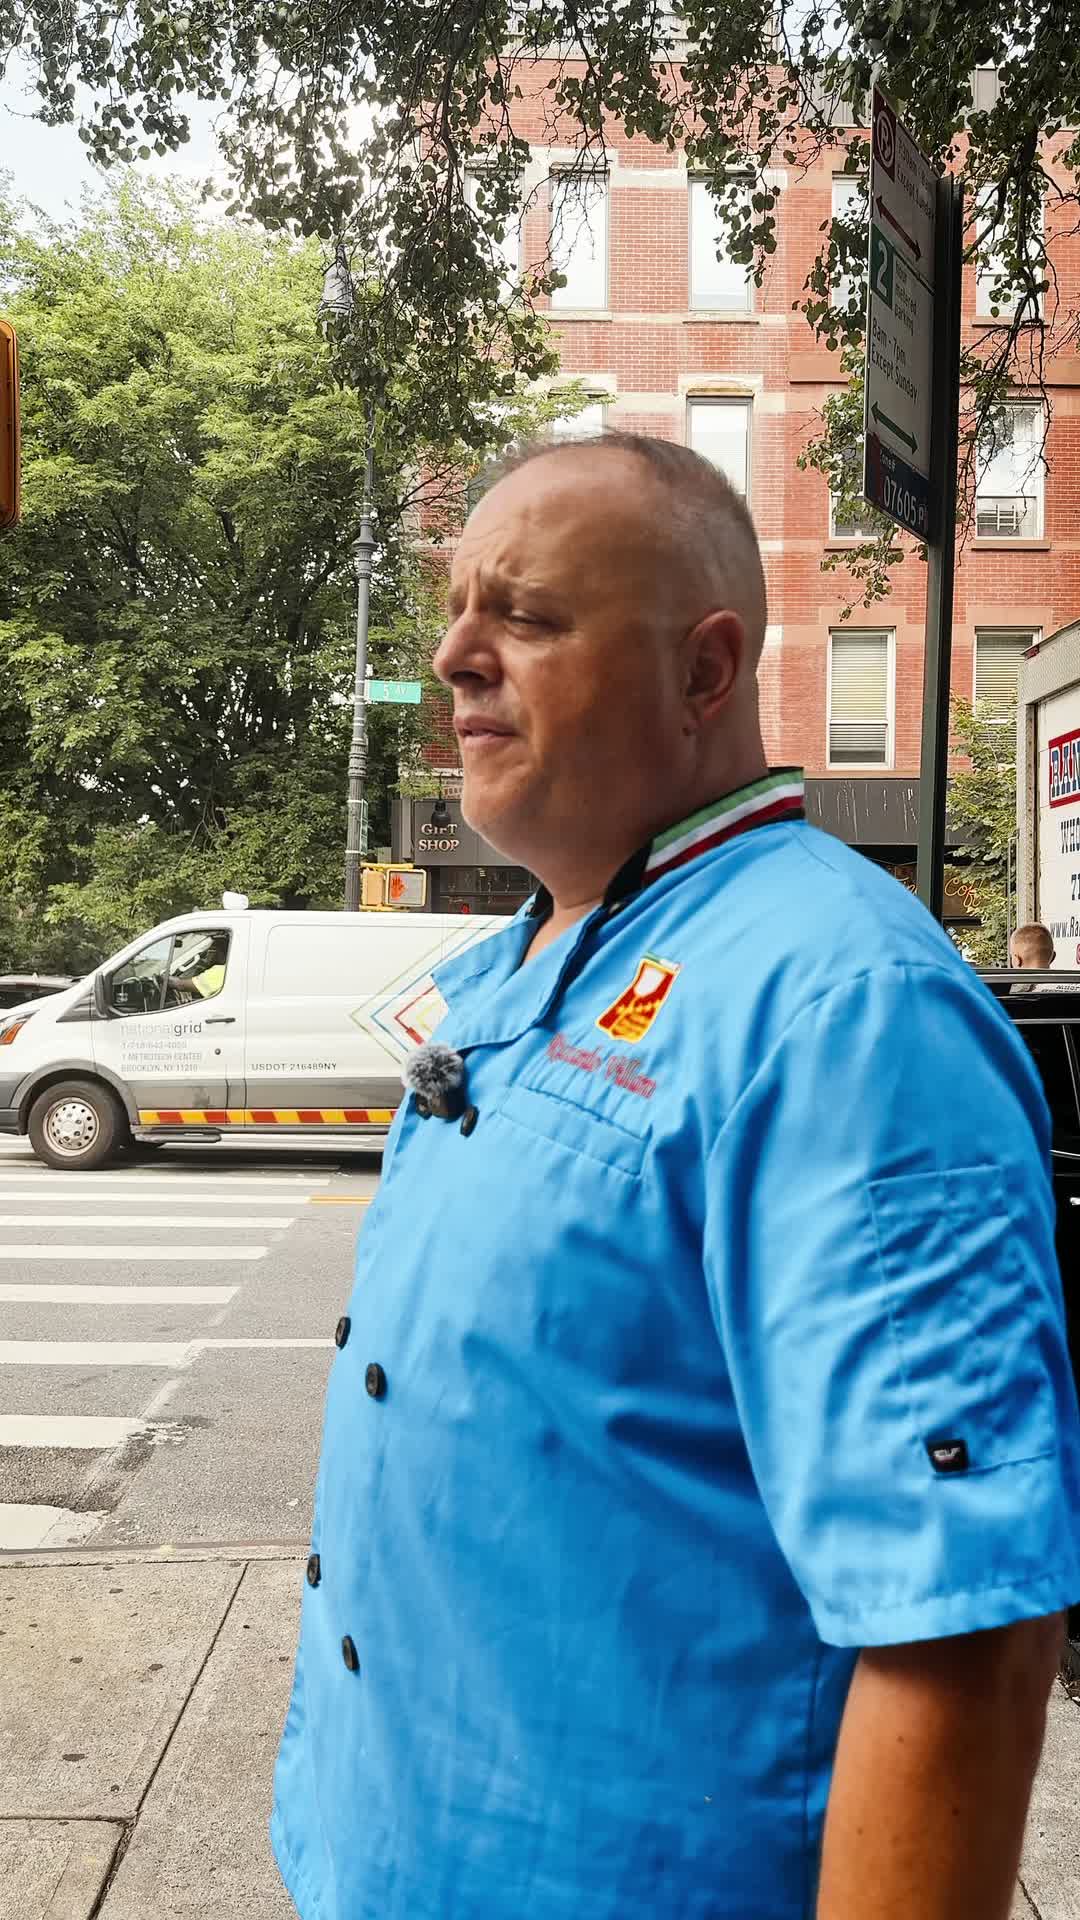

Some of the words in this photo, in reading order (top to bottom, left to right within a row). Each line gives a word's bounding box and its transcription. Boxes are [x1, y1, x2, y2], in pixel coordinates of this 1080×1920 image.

[876, 238, 889, 297] 2
[872, 316, 888, 348] 8am
[892, 335, 906, 367] 7pm
[894, 304, 914, 336] parking
[871, 343, 894, 379] Except
[894, 365, 919, 404] Sunday
[883, 475, 917, 527] 07605
[418, 839, 460, 852] SHOP
[251, 1063, 287, 1072] USDOT
